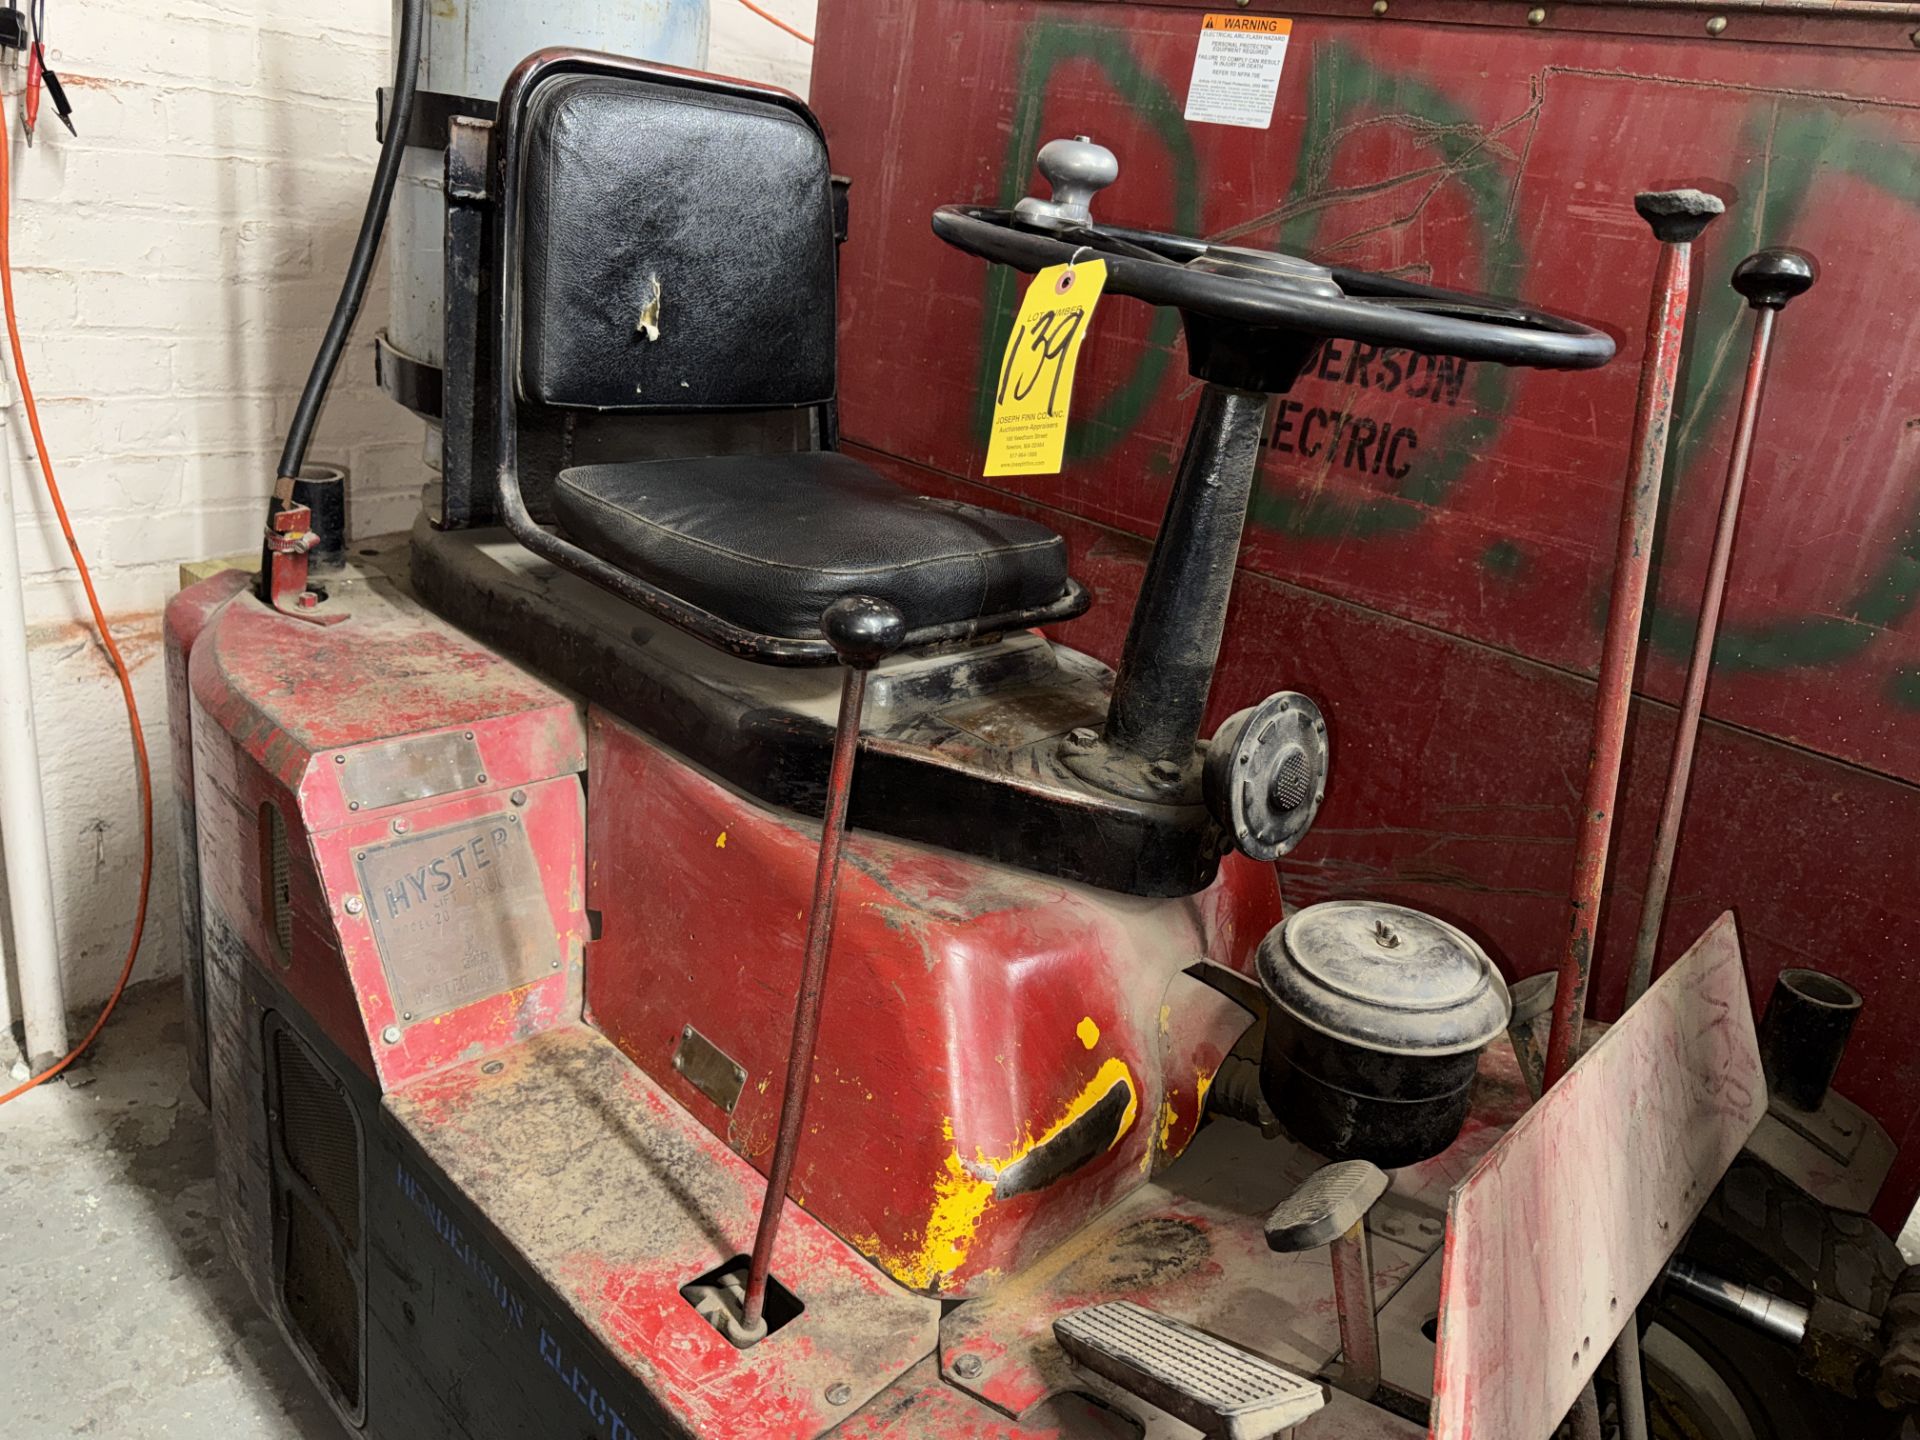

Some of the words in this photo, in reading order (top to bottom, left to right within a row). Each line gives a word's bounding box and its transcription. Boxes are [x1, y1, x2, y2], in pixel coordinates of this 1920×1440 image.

[1224, 18, 1277, 32] WARNING
[1027, 311, 1044, 322] LOT
[997, 308, 1084, 417] 139
[996, 415, 1020, 425] JOSEPH
[1259, 400, 1417, 480] ECTRIC
[384, 826, 509, 919] HYSTER
[397, 1162, 524, 1329] HENDERSON
